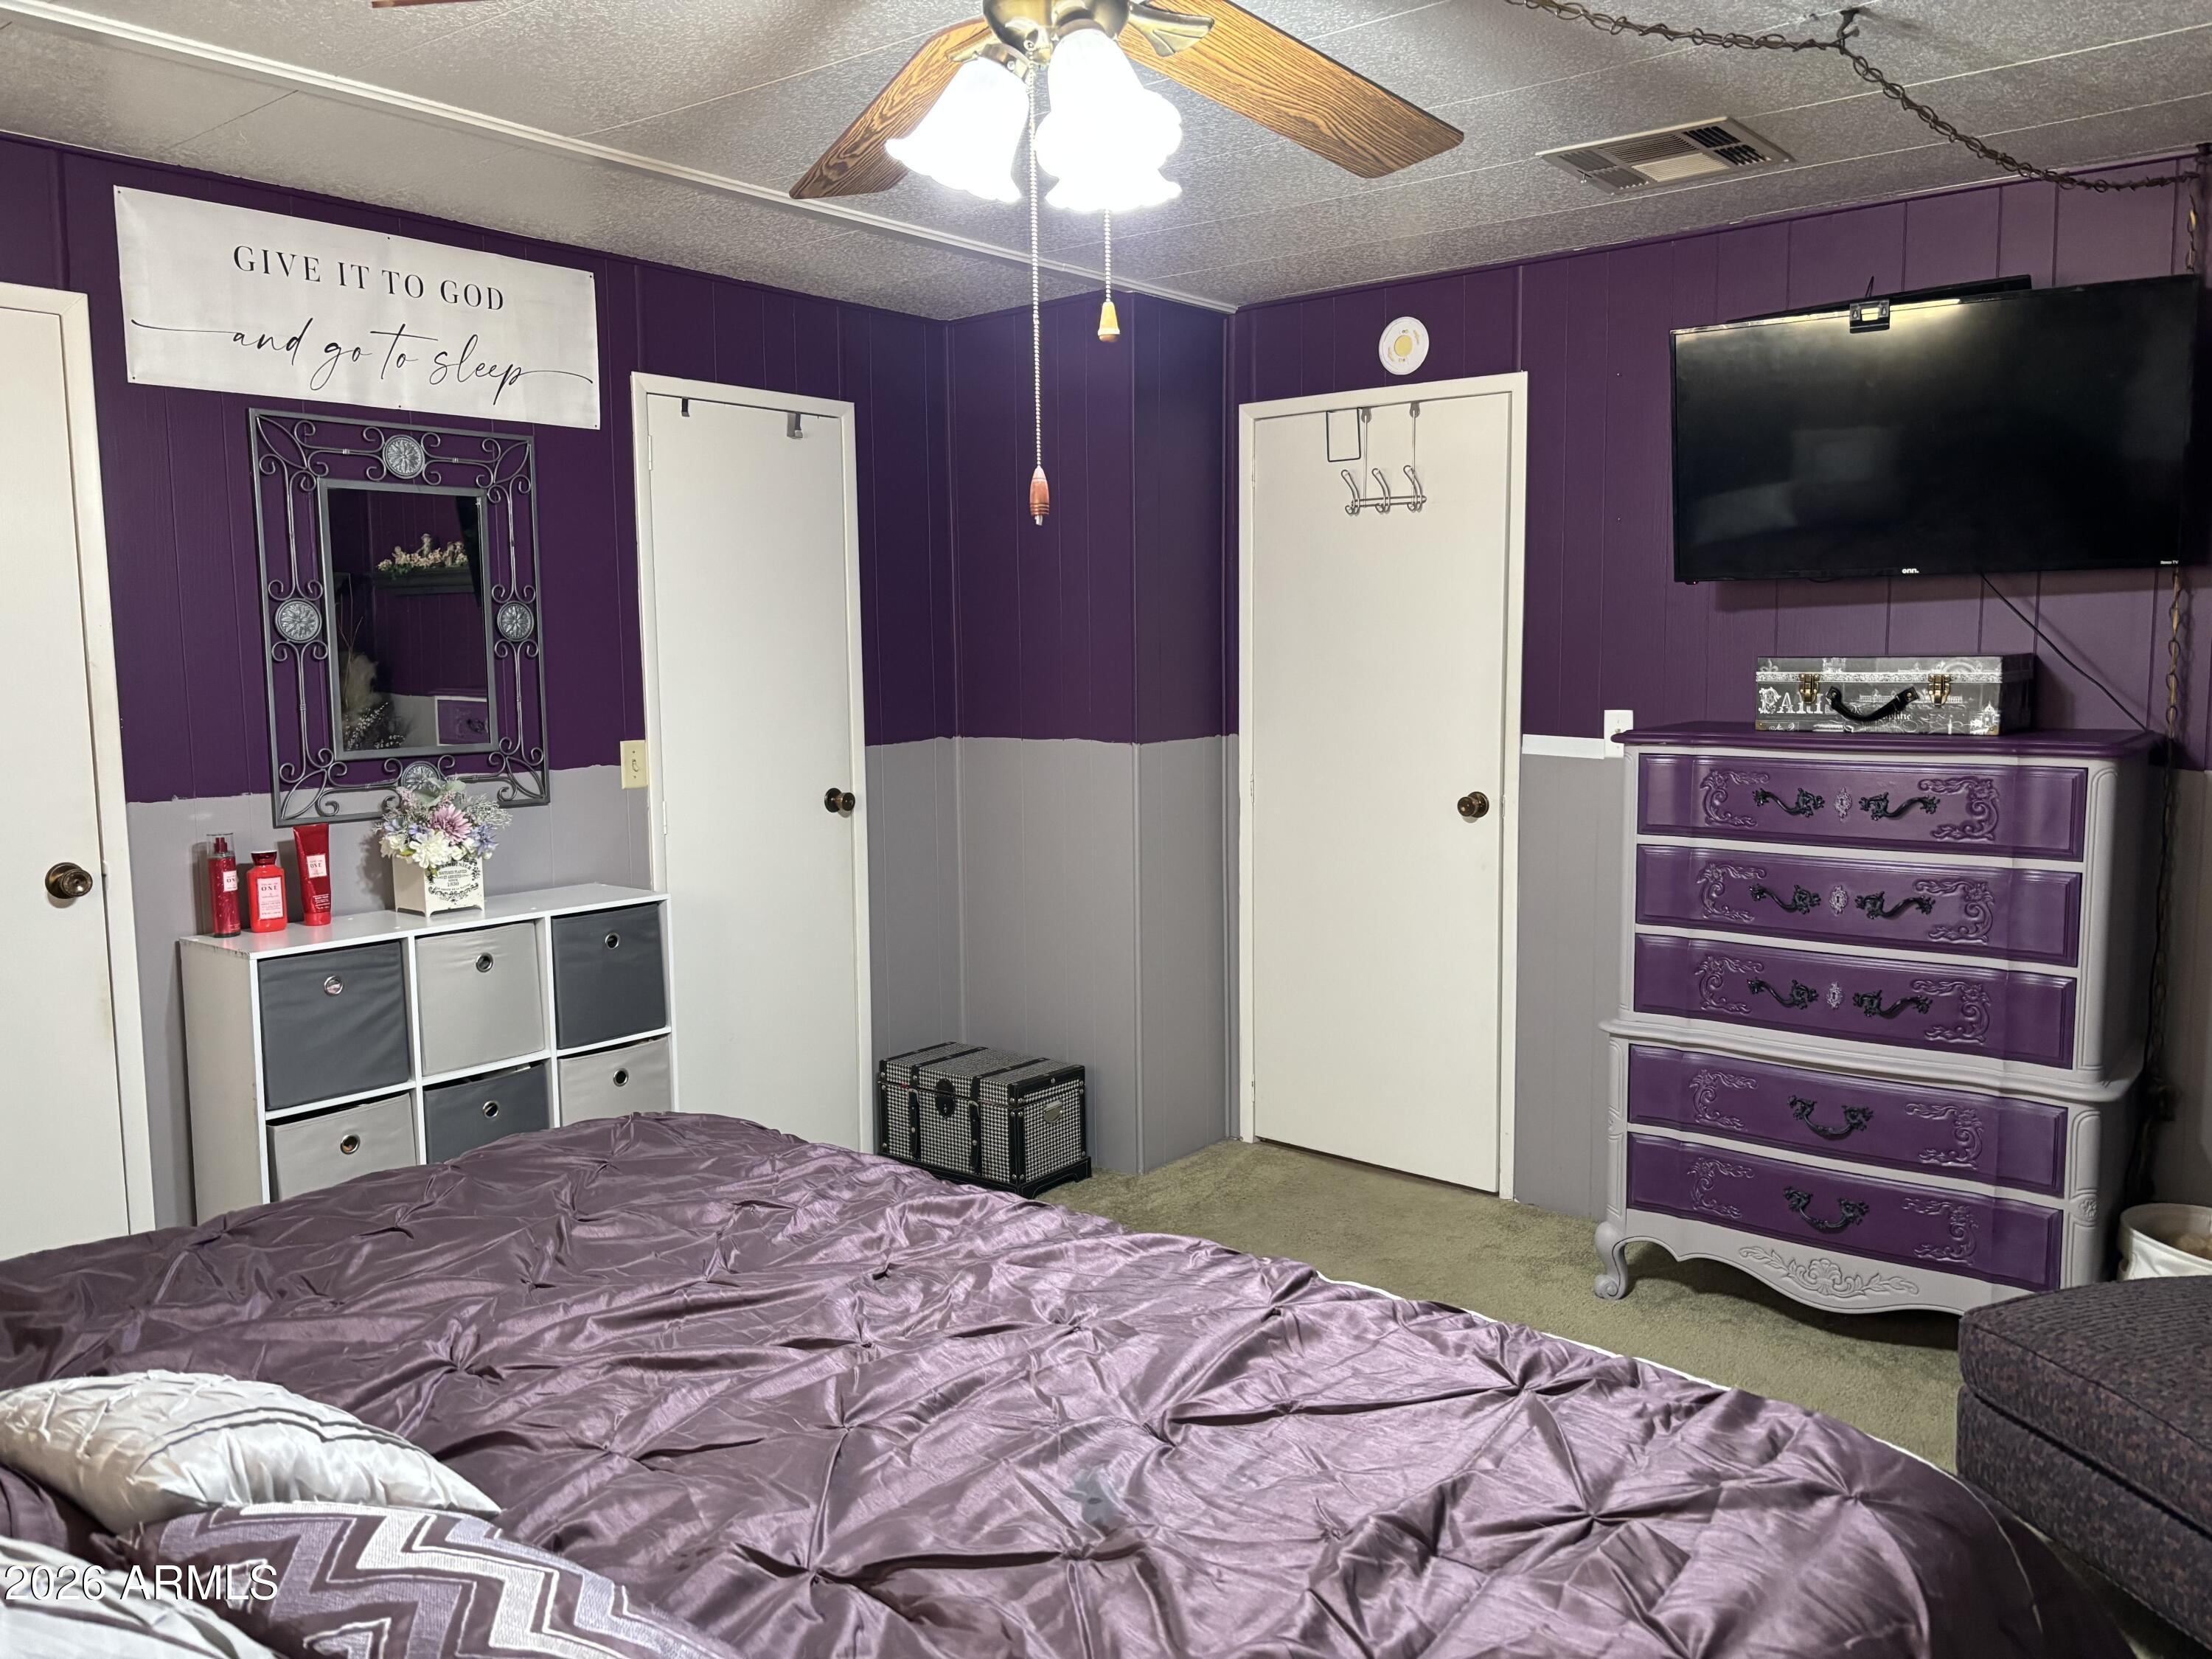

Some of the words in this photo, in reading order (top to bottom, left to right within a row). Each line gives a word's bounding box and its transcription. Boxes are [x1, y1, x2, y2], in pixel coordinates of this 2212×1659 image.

[233, 245, 321, 284] GIVE
[338, 261, 370, 289] IT
[382, 269, 425, 299] TO
[440, 279, 505, 311] GOD
[310, 342, 372, 392] go
[370, 323, 439, 380] to
[429, 335, 593, 406] sleep
